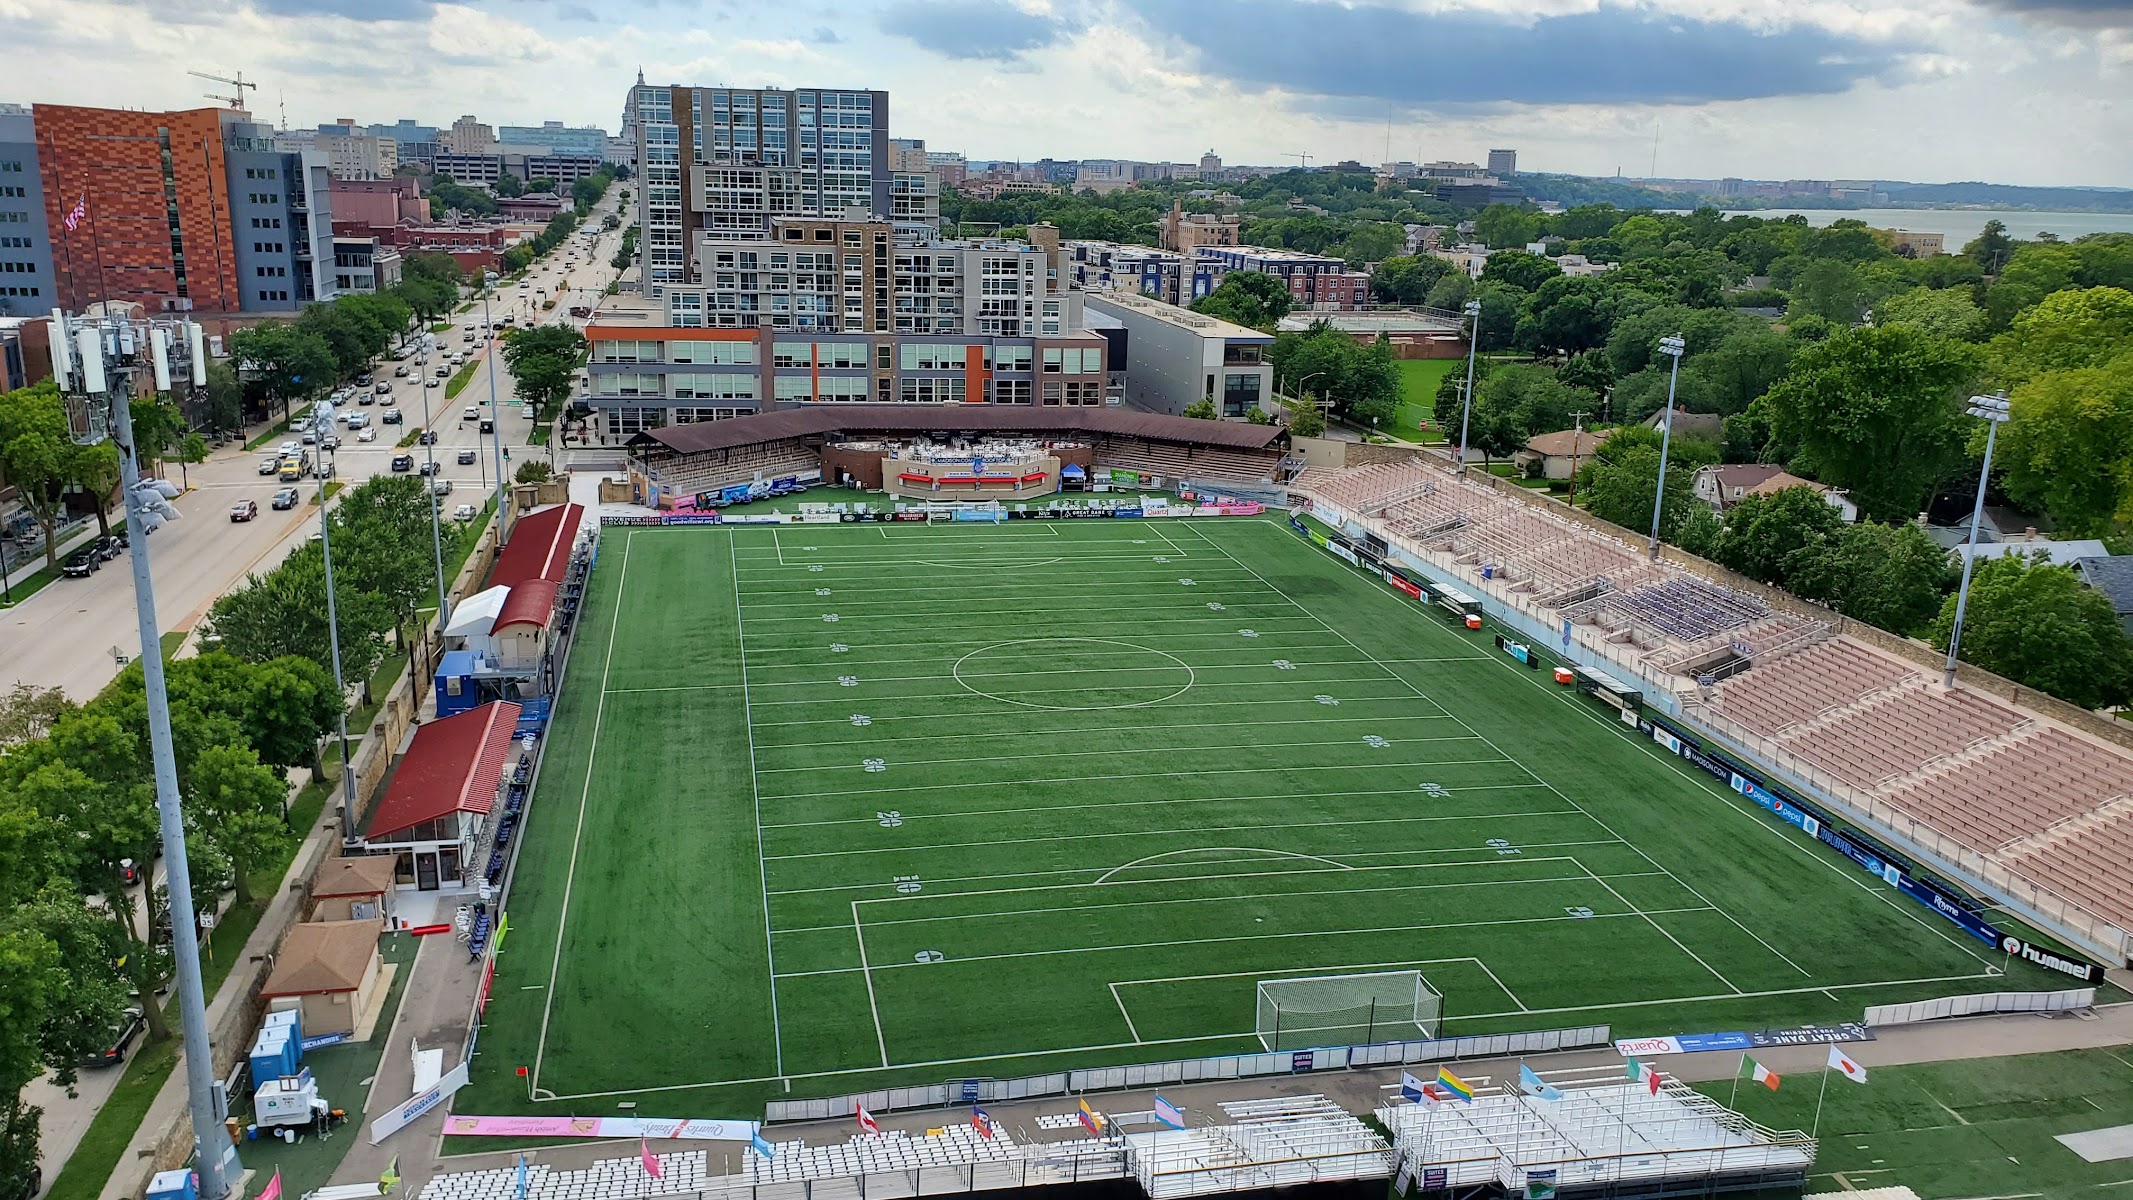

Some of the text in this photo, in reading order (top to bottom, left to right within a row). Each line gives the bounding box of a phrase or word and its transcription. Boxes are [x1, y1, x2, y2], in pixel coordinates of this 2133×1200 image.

[1148, 508, 1168, 516] Quartz
[1555, 672, 1561, 681] G
[1692, 753, 1727, 780] MADISON.COM
[1753, 790, 1801, 823] pepsi pepsi
[1934, 895, 1959, 917] Rhyme
[201, 919, 213, 927] 35
[2021, 942, 2093, 981] hummel
[301, 1034, 340, 1050] ERCHANDISE
[1773, 1035, 1807, 1044] DANE
[1808, 1032, 1850, 1042] GREAT
[1619, 1039, 1671, 1053] Quartz
[1294, 1053, 1313, 1062] SUITES
[643, 1122, 677, 1135] Brady
[686, 1123, 724, 1136] Quarles
